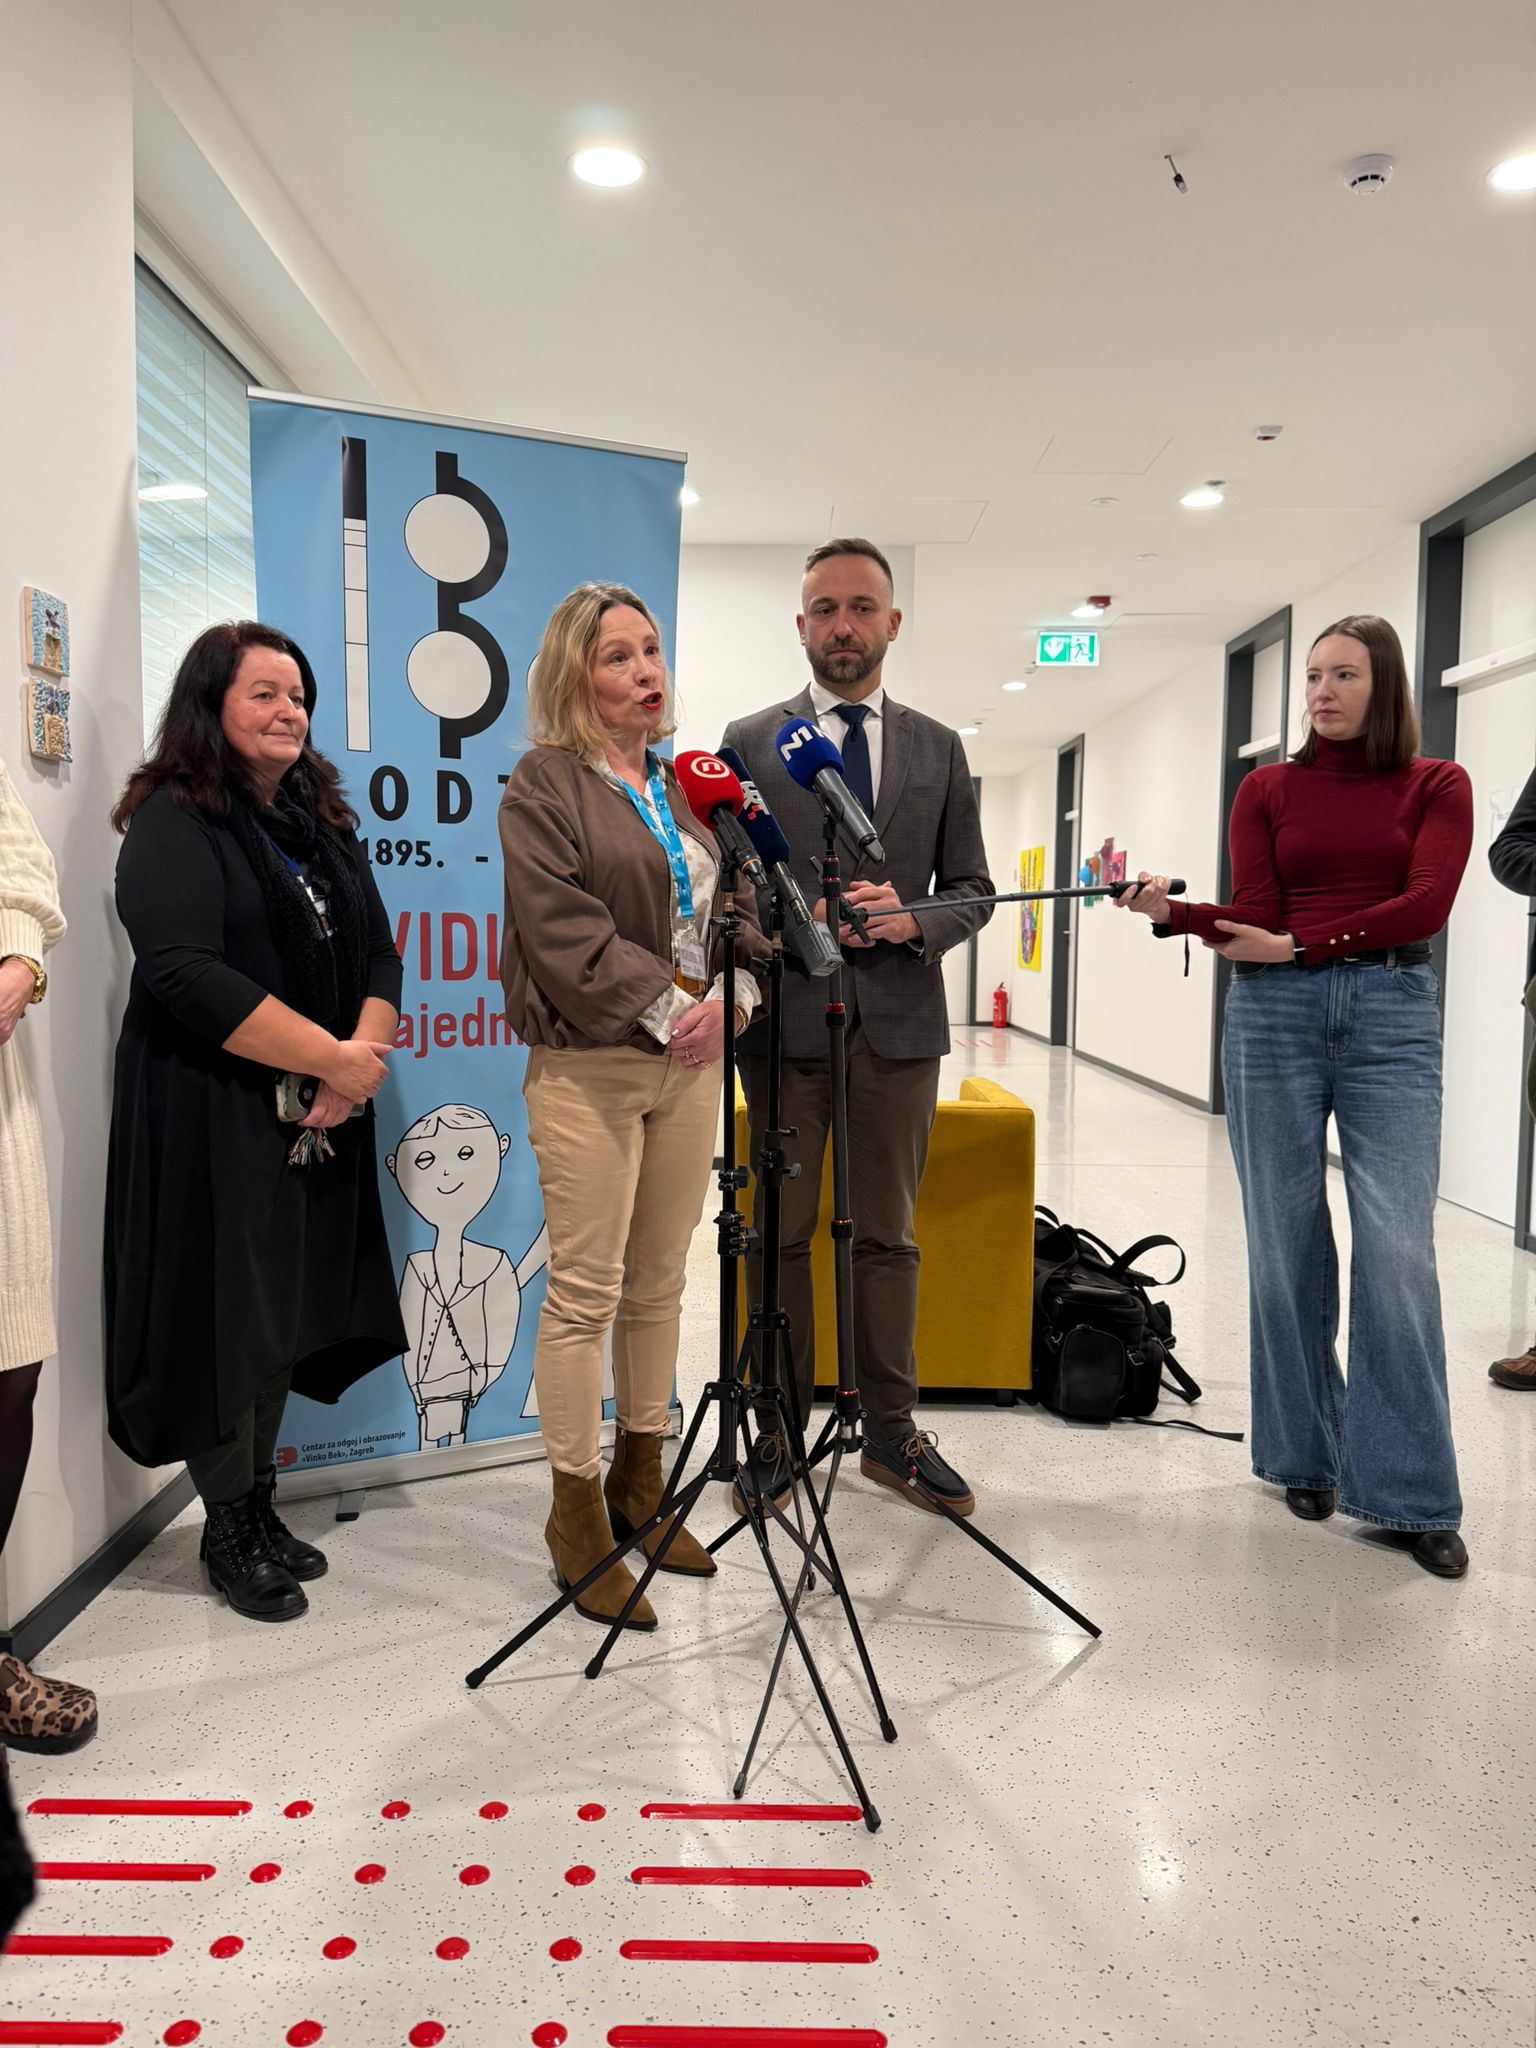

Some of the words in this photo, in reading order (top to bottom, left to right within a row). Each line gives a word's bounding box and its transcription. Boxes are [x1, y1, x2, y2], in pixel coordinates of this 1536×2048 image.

[780, 725, 814, 762] N1
[369, 764, 512, 824] OD
[359, 837, 445, 868] 1895.
[391, 997, 524, 1058] ajedn
[302, 1441, 326, 1452] Centar
[337, 1437, 358, 1448] odgoj
[363, 1431, 406, 1444] obrazovanje
[349, 1445, 375, 1457] Zagreb
